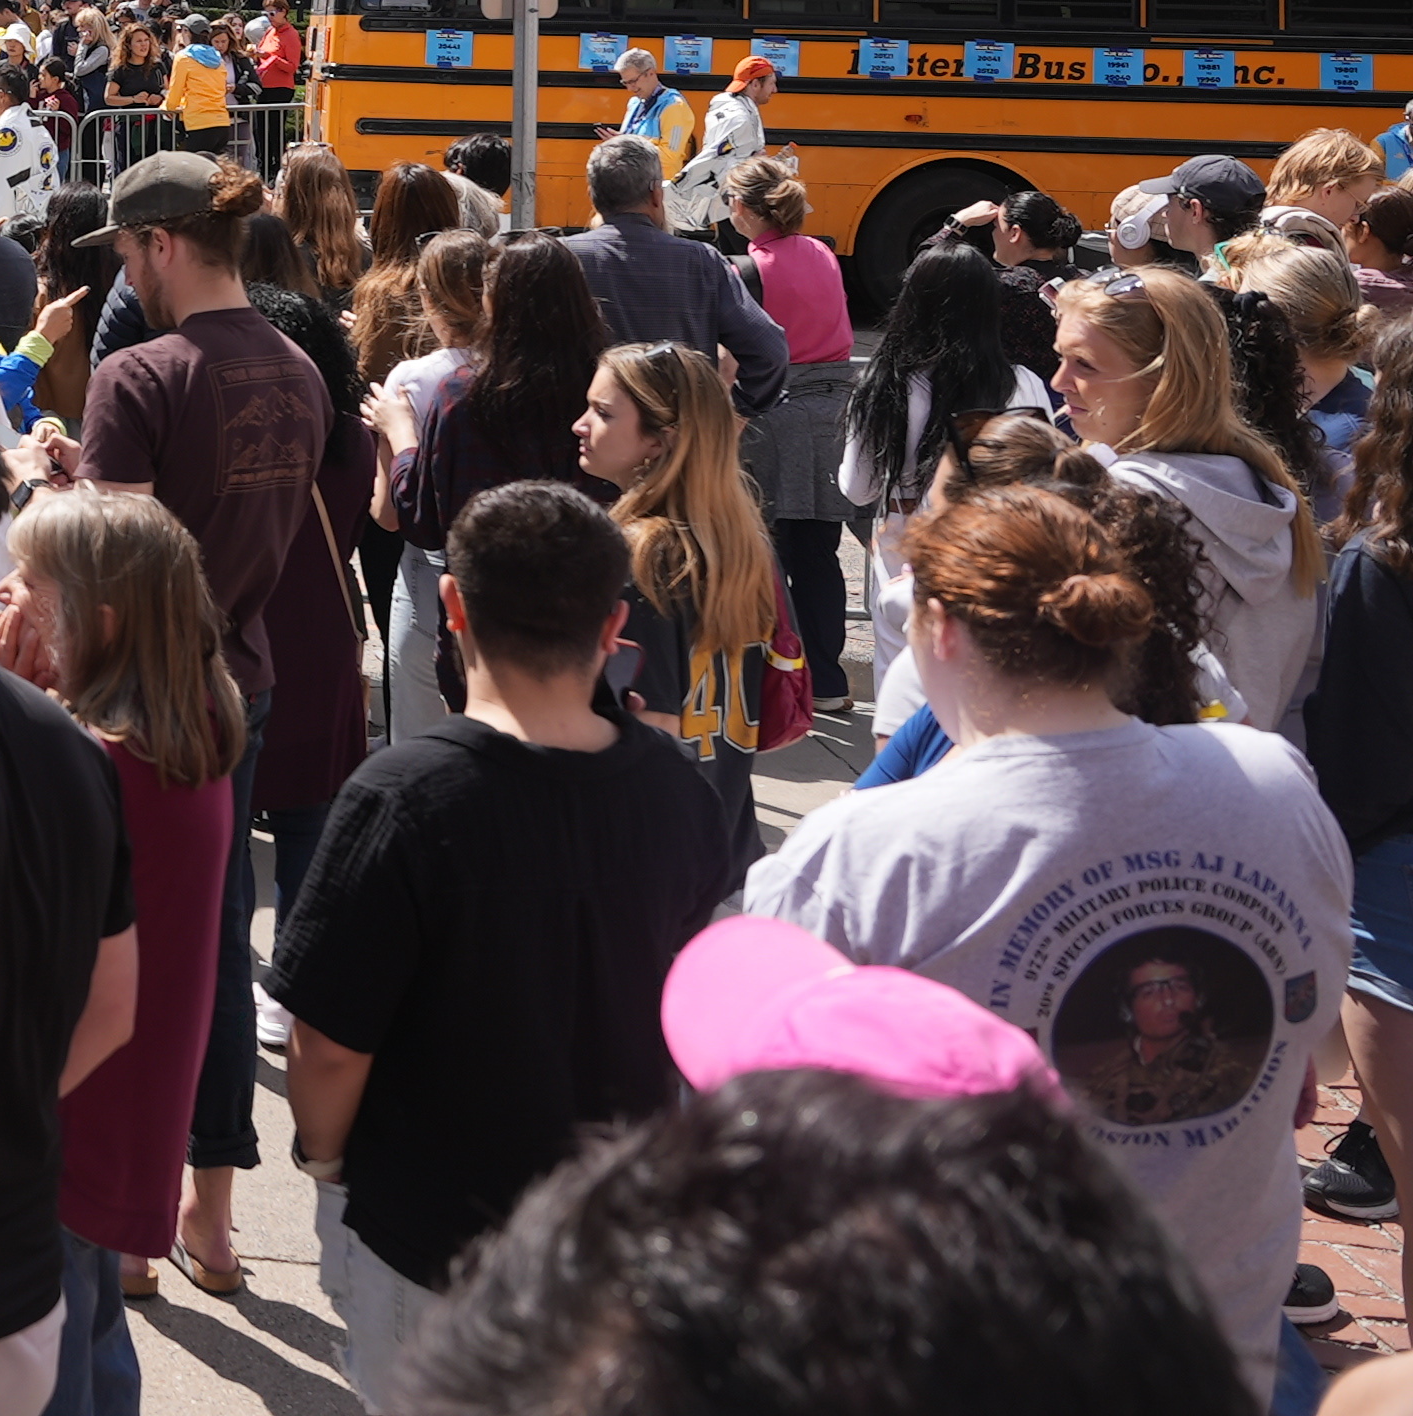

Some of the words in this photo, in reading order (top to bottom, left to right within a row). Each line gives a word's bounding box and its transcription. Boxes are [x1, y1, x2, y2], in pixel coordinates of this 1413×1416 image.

[1014, 53, 1085, 82] Bus
[1233, 64, 1285, 86] nc.
[1335, 66, 1358, 74] 19801
[1081, 860, 1114, 887] OF
[1121, 850, 1182, 873] MSG
[1191, 851, 1224, 875] AJ
[1053, 882, 1133, 939] MILITARY
[1138, 877, 1207, 895] POLICE
[1212, 882, 1286, 934] COMPANY
[1230, 860, 1314, 952] LAPANNA
[999, 879, 1078, 974] MEMORY
[1052, 918, 1112, 980] SPECIAL
[1111, 899, 1186, 927] FORCES
[1190, 901, 1255, 935] GROUP
[1254, 932, 1288, 977] (ABN)
[988, 978, 1012, 1010] IN
[1089, 1125, 1170, 1147] OSTON
[1182, 1039, 1288, 1148] MARATHON
